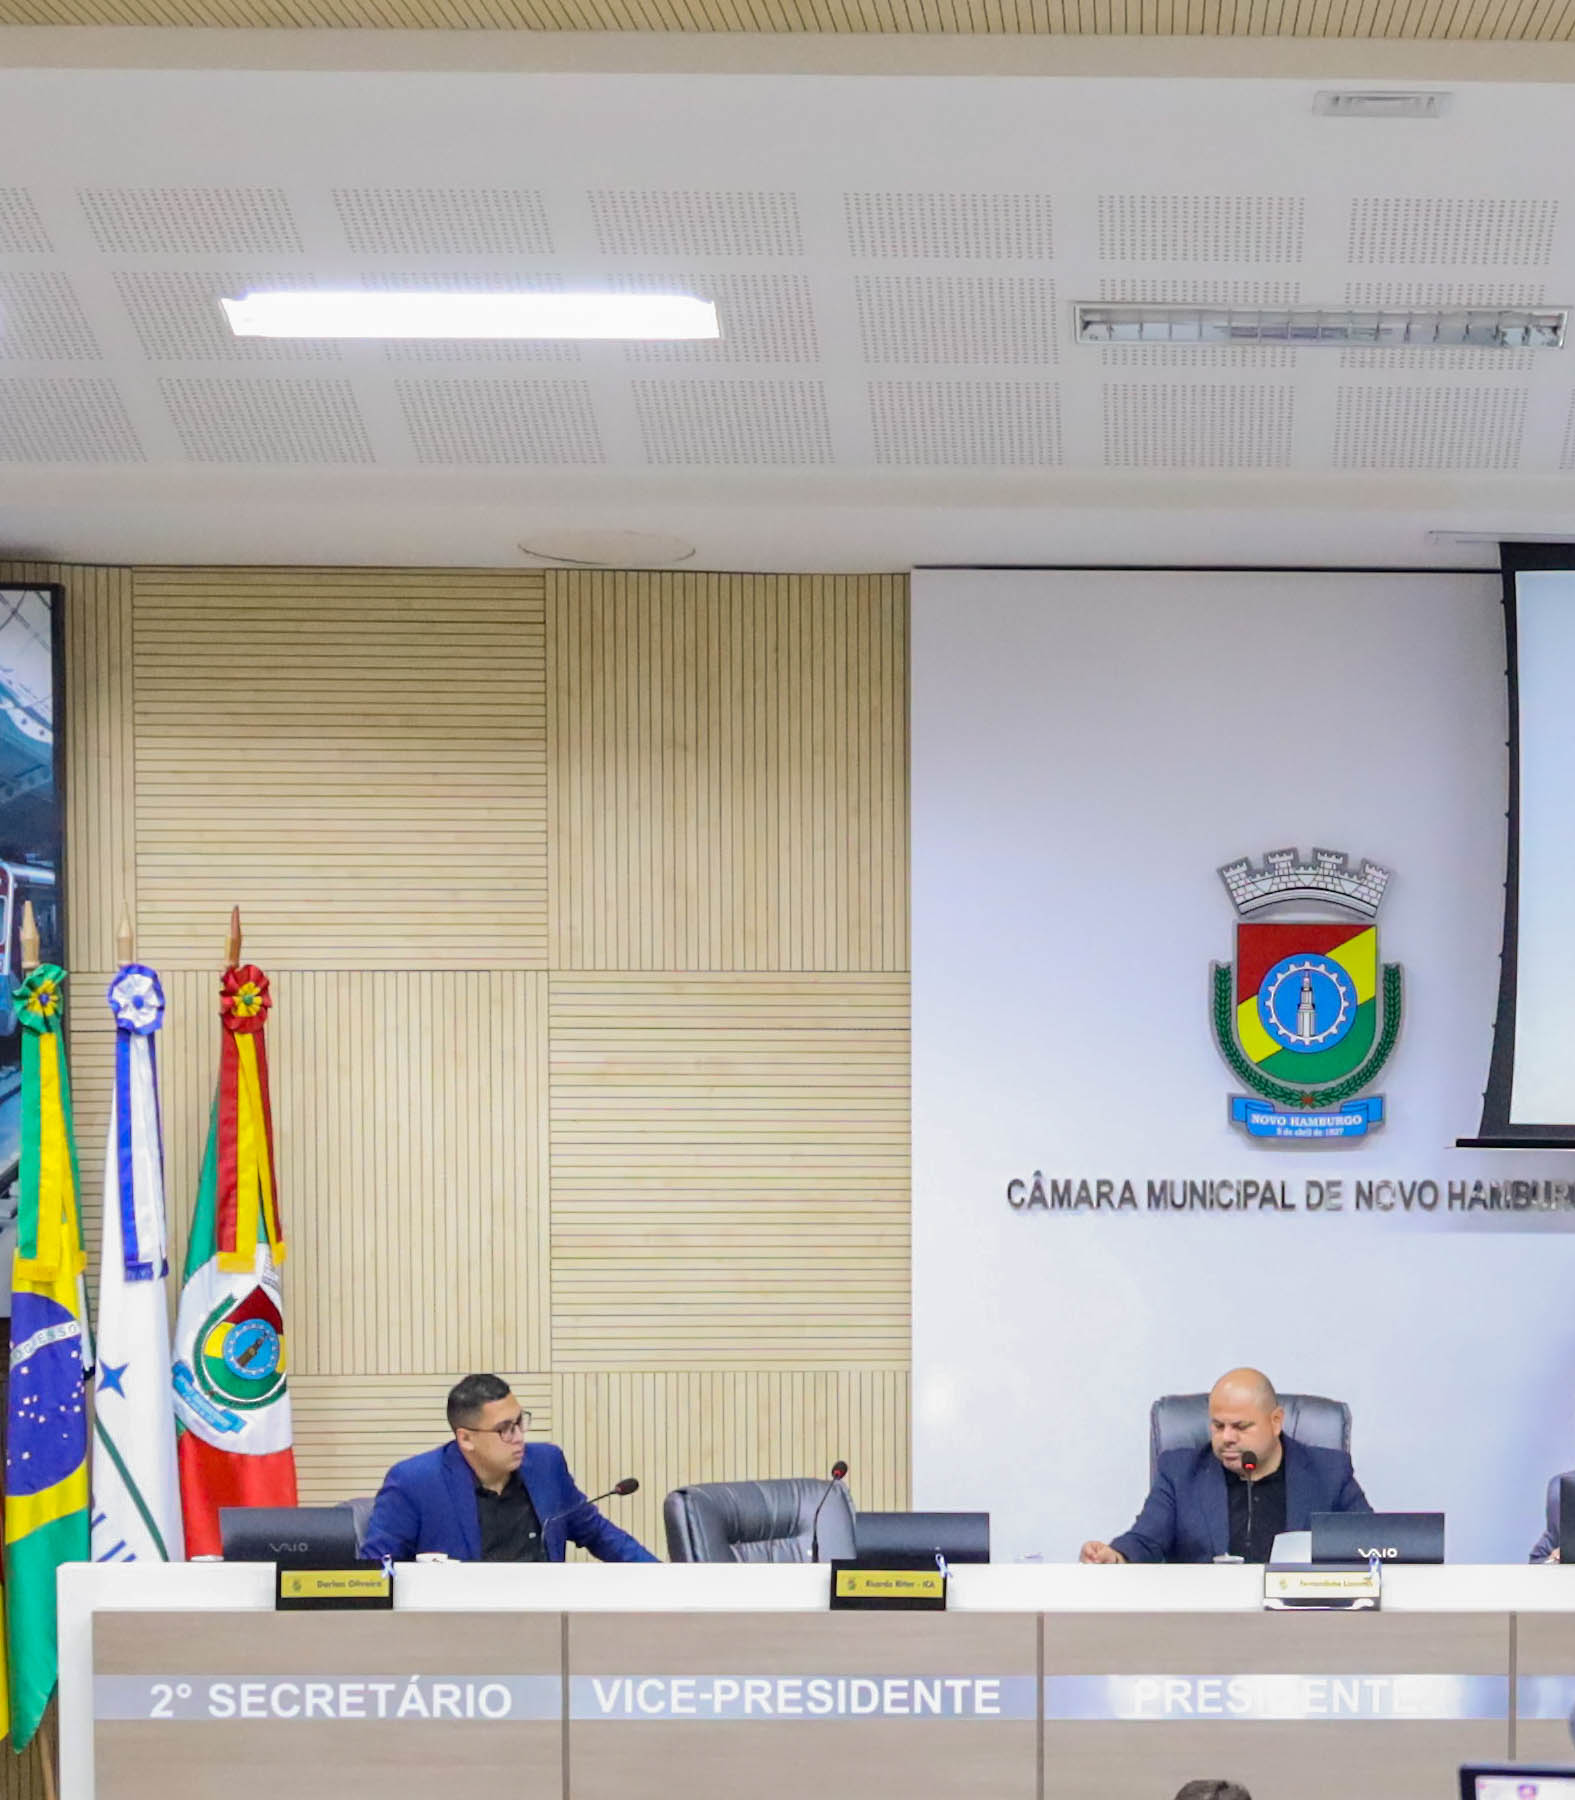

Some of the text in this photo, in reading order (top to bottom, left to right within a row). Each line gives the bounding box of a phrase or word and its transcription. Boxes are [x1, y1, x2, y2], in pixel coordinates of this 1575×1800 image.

[1250, 1113, 1363, 1127] NOVO HAMBURGO
[1006, 1170, 1138, 1212] CÂMARA
[1146, 1179, 1297, 1212] MUNICIPAL
[1305, 1179, 1343, 1211] DE
[1355, 1179, 1440, 1211] NOVO
[1357, 1547, 1398, 1558] VAIO
[207, 1674, 514, 1719] SECRETÁRIO
[591, 1678, 1003, 1716] VICE-PRESIDENTE
[1133, 1678, 1418, 1714] PRESENTE
